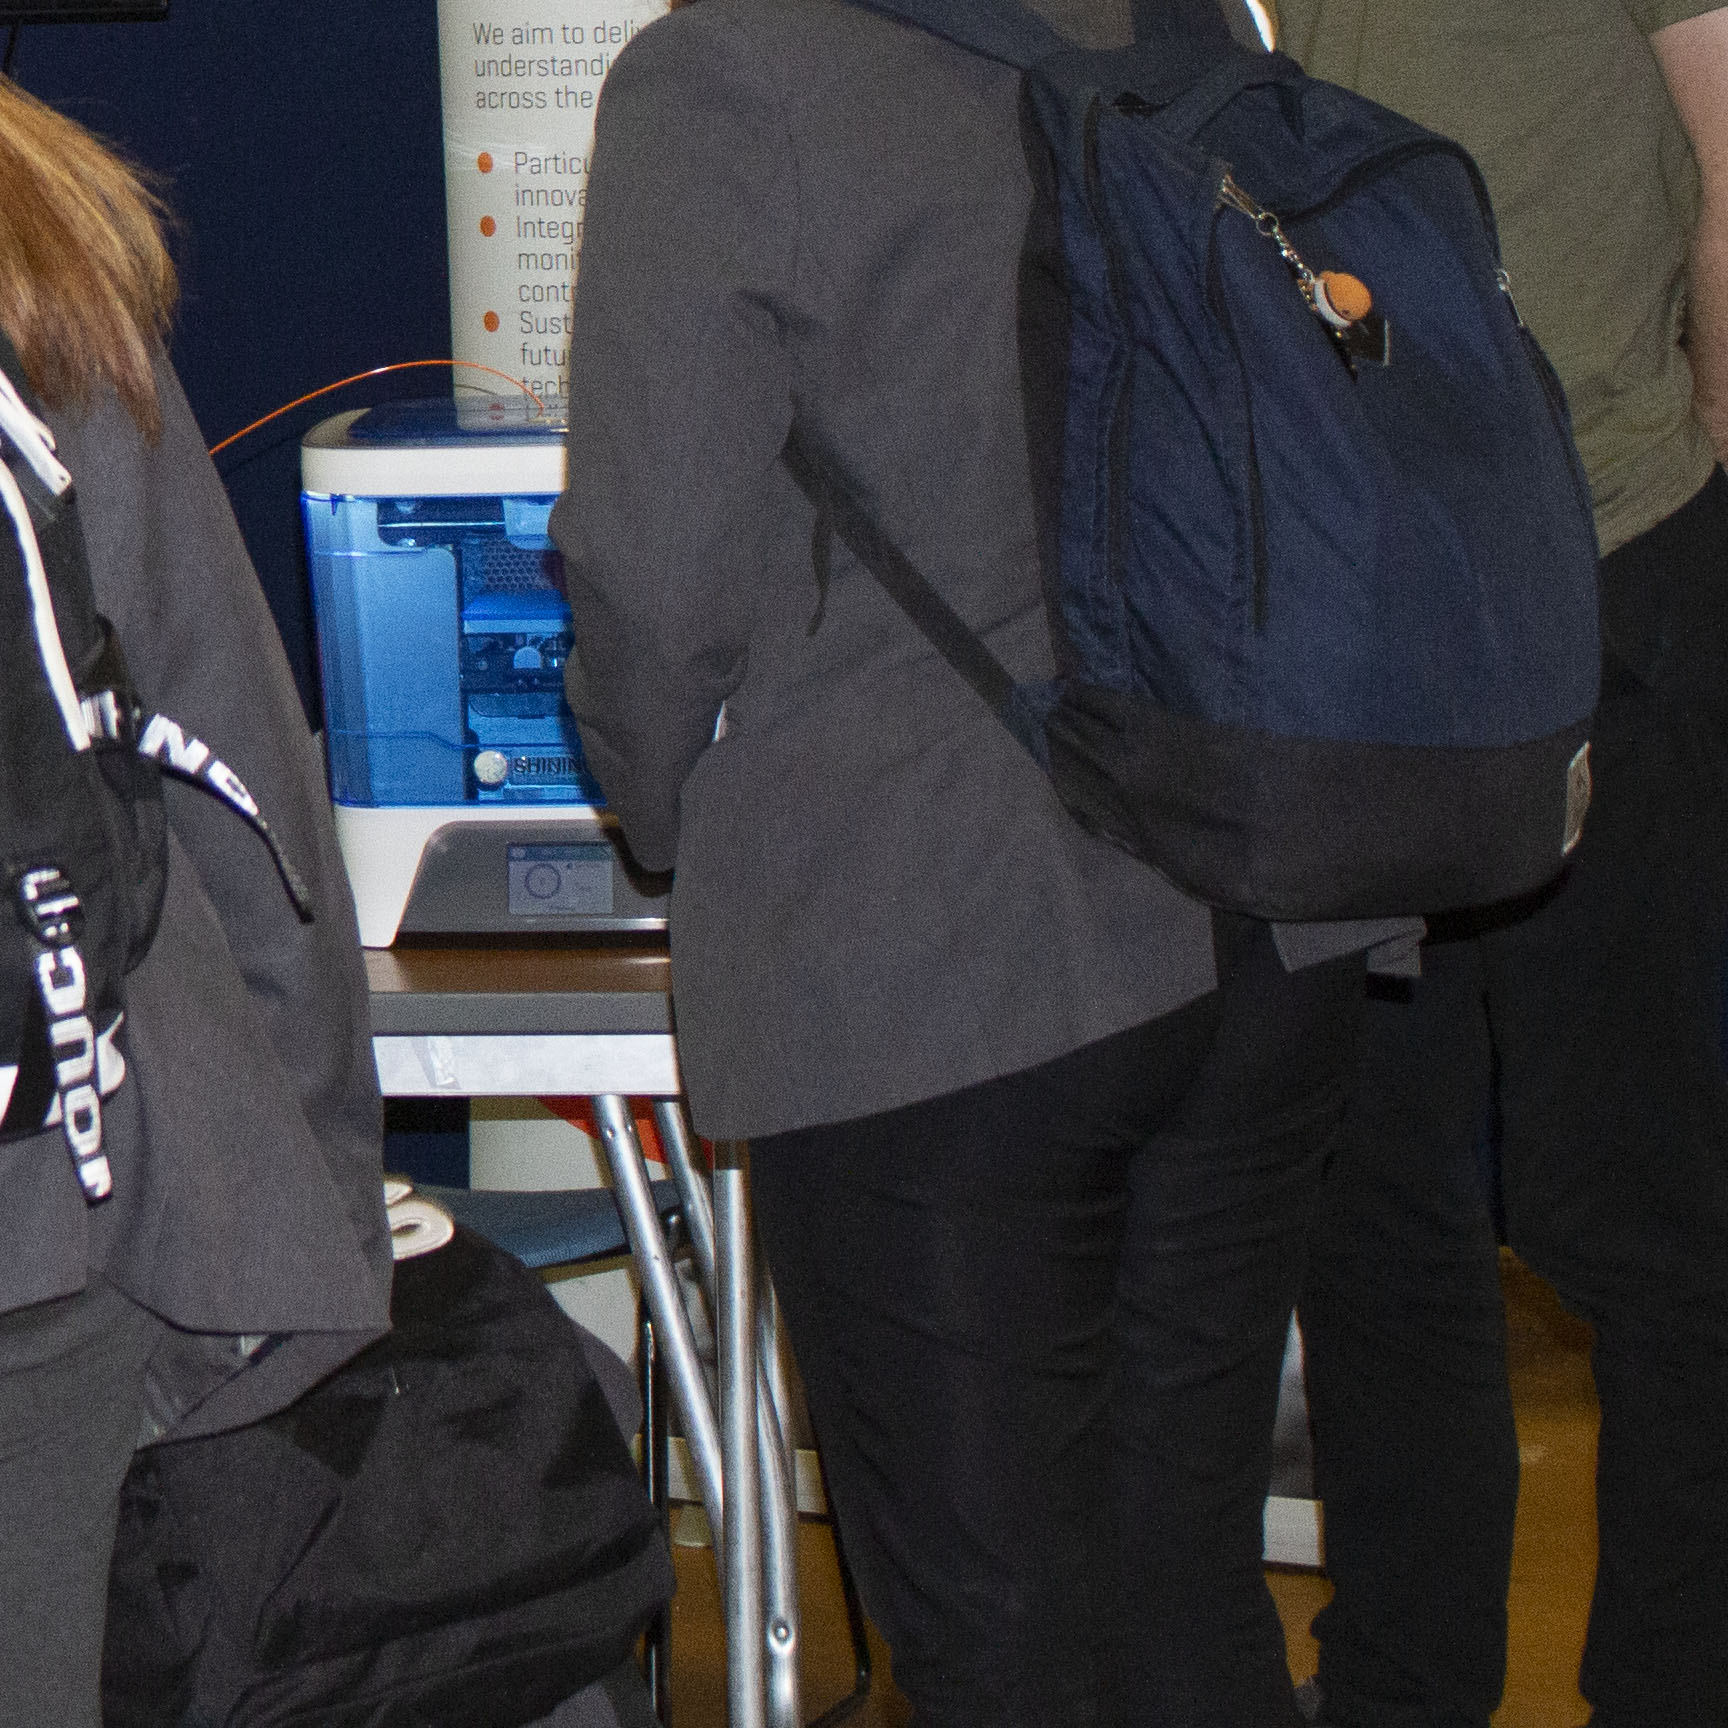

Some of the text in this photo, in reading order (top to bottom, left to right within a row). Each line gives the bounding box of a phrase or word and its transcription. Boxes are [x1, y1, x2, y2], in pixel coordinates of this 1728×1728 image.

[473, 22, 503, 45] We
[512, 22, 553, 45] aim
[562, 24, 584, 44] to
[476, 85, 593, 109] across the
